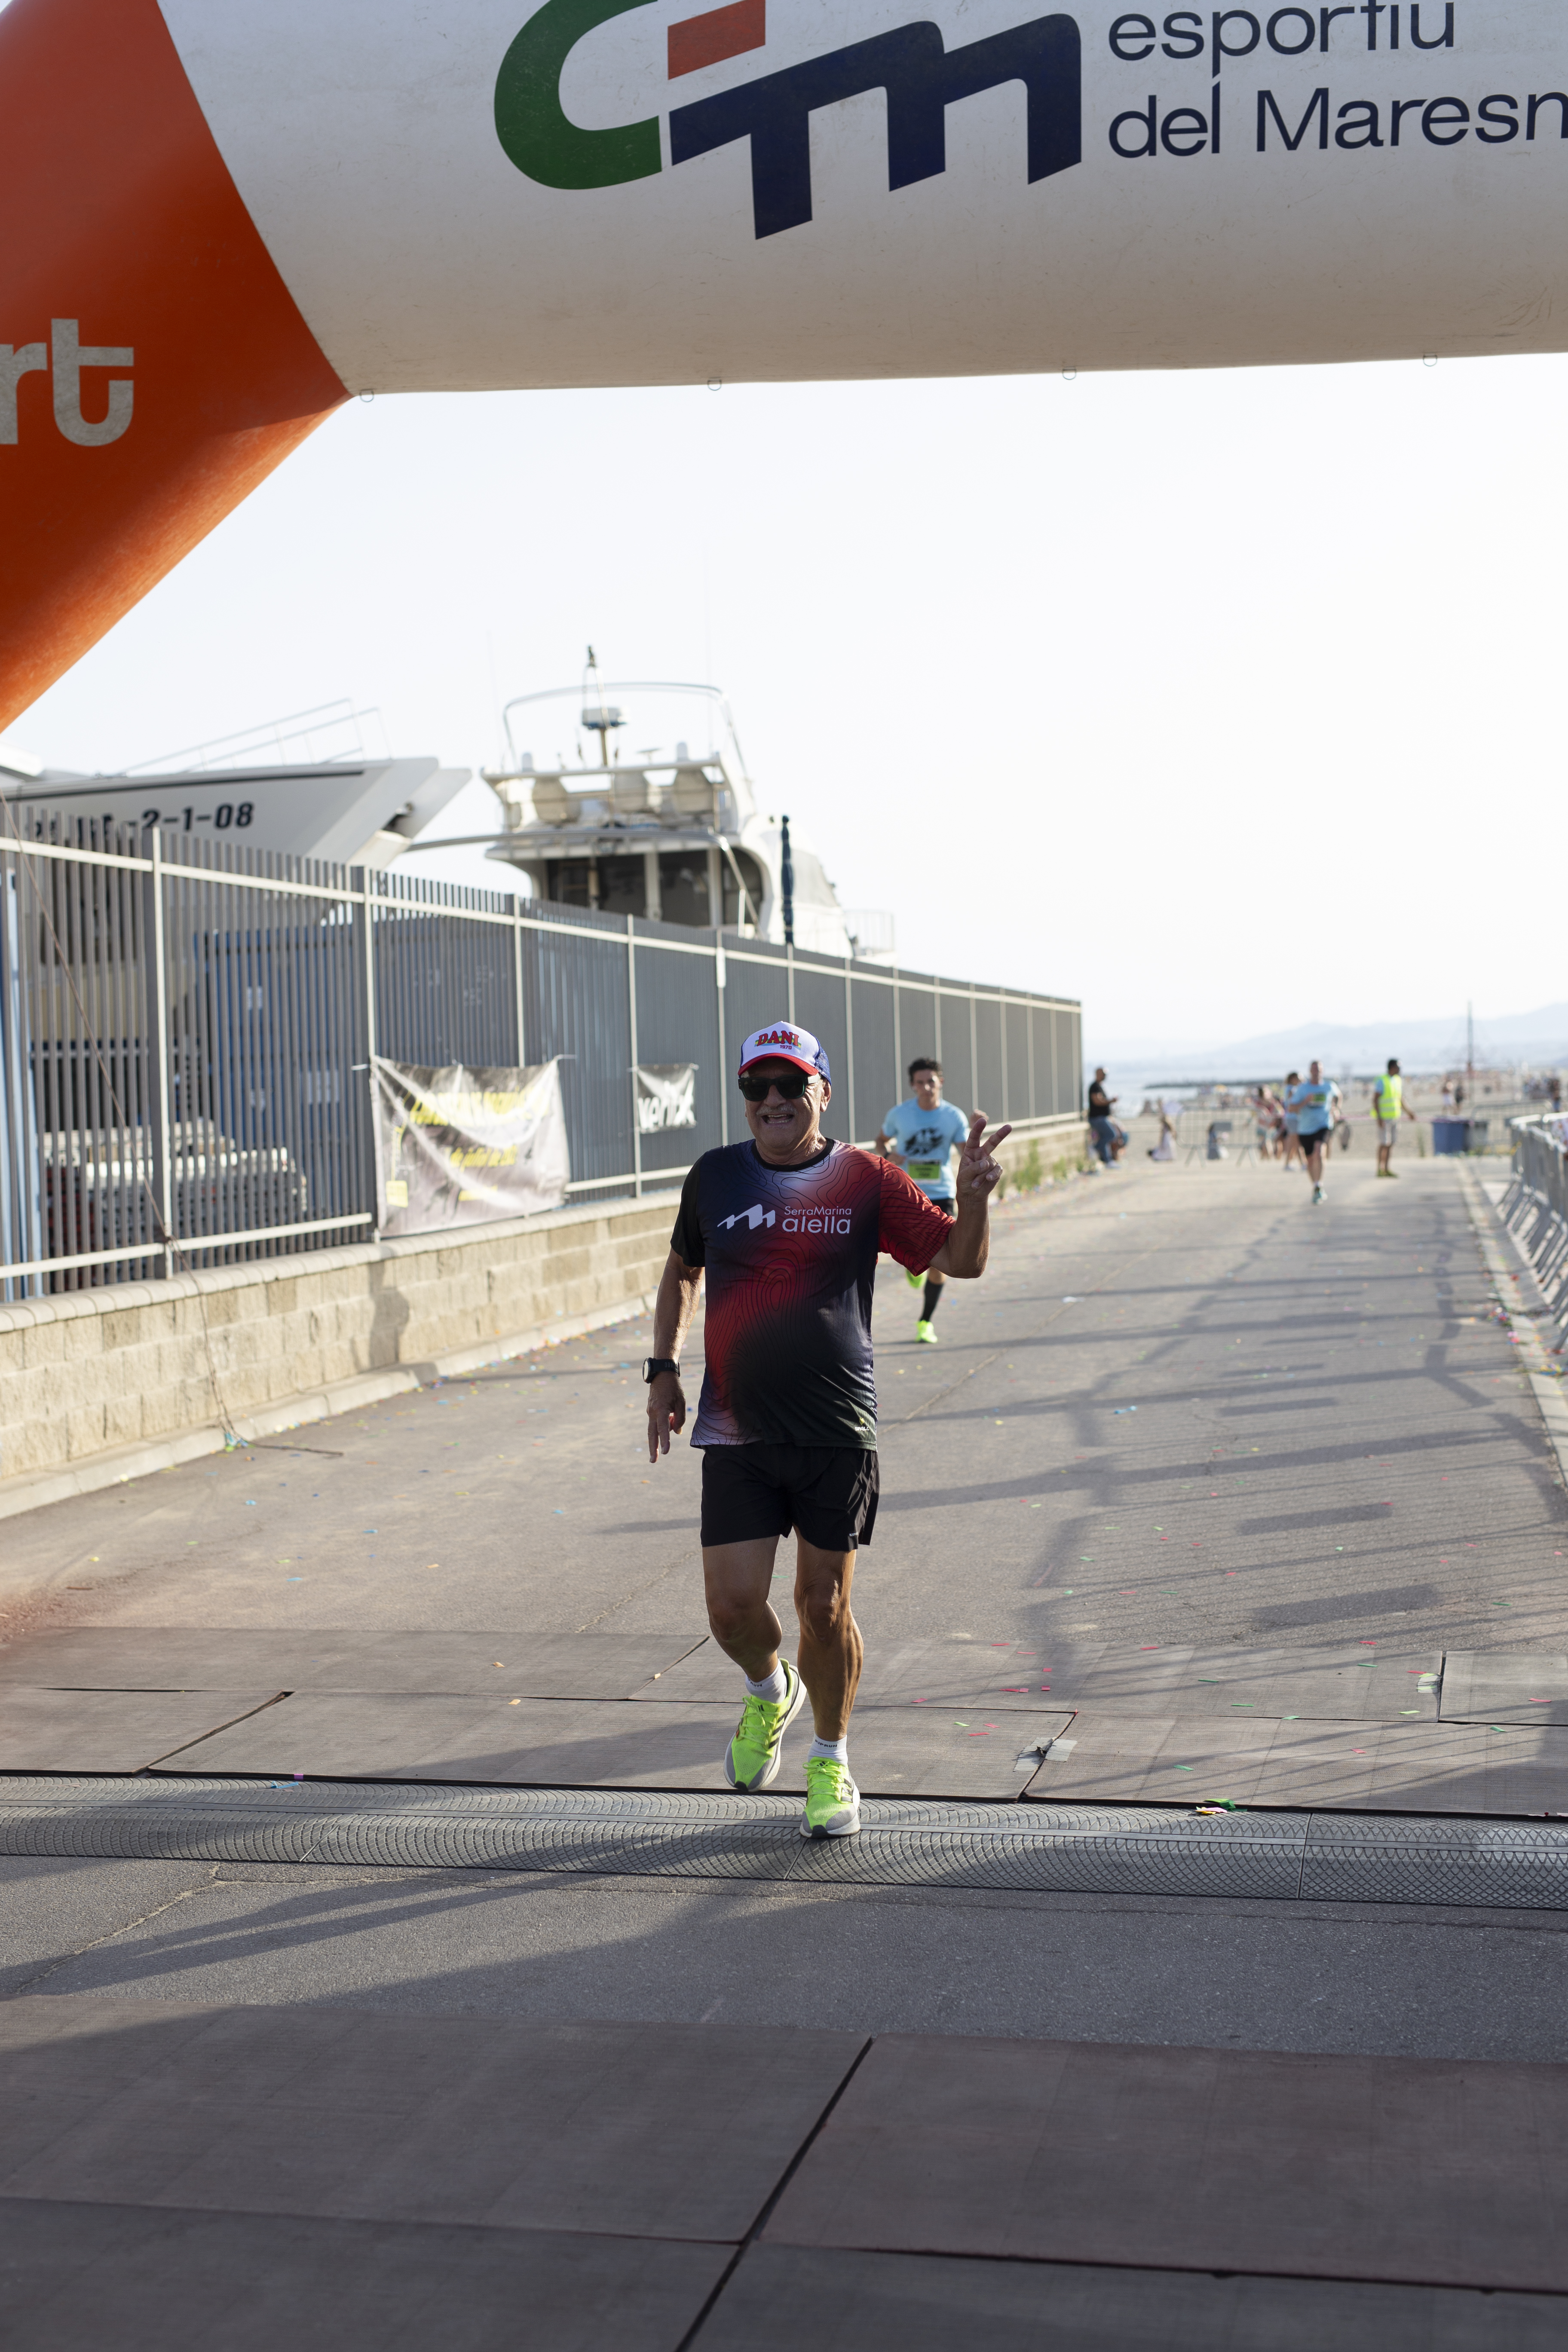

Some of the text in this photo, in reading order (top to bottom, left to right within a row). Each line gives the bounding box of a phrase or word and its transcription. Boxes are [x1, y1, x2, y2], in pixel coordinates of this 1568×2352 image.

[1109, 0, 1454, 79] esportiu
[1109, 81, 1221, 158] del
[756, 1030, 799, 1047] DANI
[784, 1206, 852, 1216] SerraMarina
[782, 1216, 851, 1234] alella
[815, 1739, 838, 1748] KIPRUN
